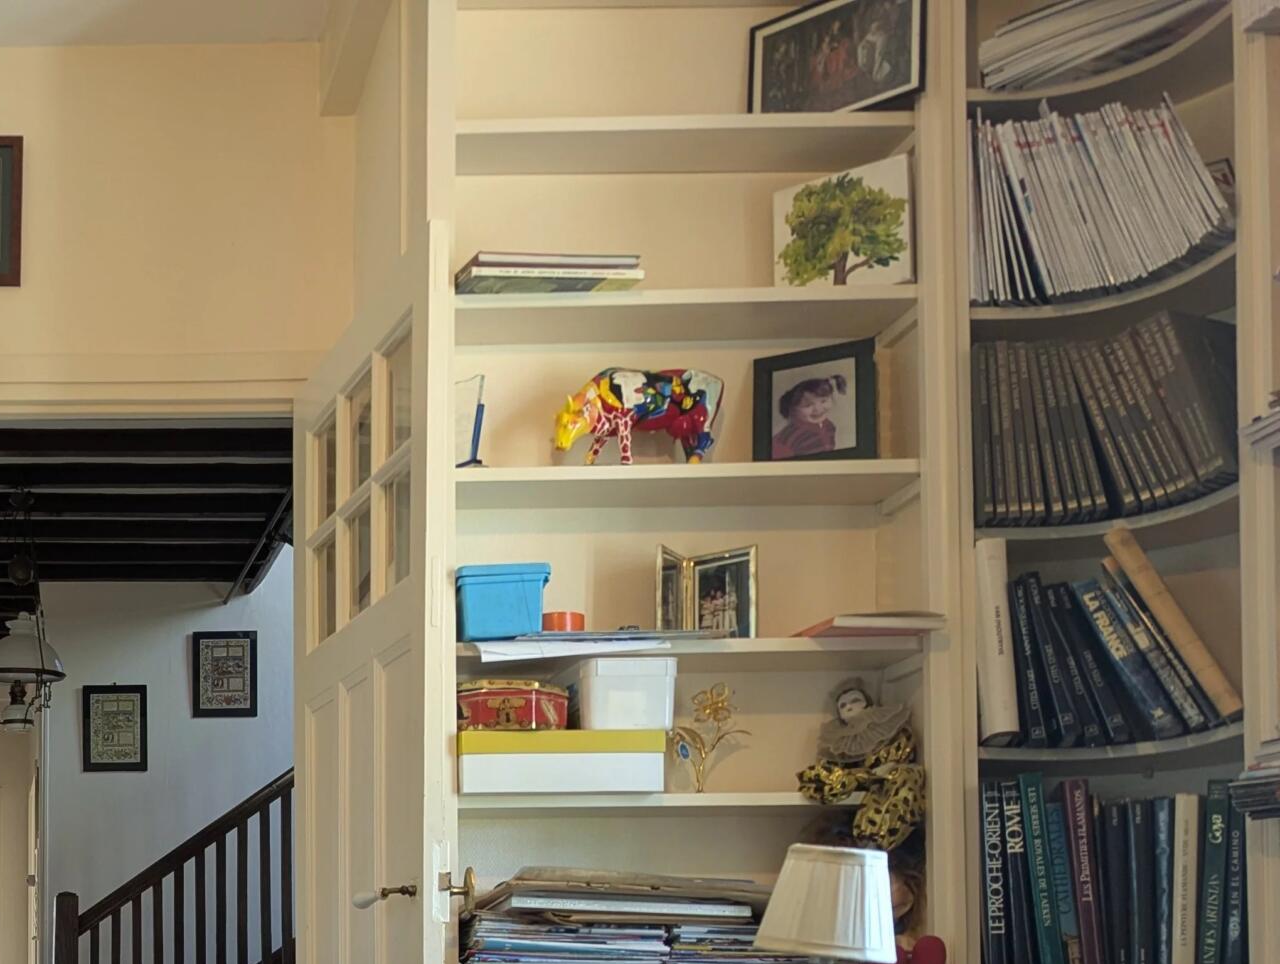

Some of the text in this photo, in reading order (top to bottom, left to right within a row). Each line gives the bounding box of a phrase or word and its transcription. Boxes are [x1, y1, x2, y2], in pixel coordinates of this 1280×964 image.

[1083, 592, 1101, 612] LA
[1093, 611, 1128, 661] FRANCE
[1028, 787, 1037, 802] LES
[1075, 789, 1087, 837] FLAMANDS
[1005, 800, 1024, 853] ROME
[1030, 804, 1041, 836] SERRES
[1209, 814, 1222, 843] Goya
[985, 802, 1005, 934] LE PROCHE-ORIENT
[1034, 838, 1046, 876] ROYALES
[1231, 830, 1240, 871] CAMINO
[1081, 883, 1093, 901] LES
